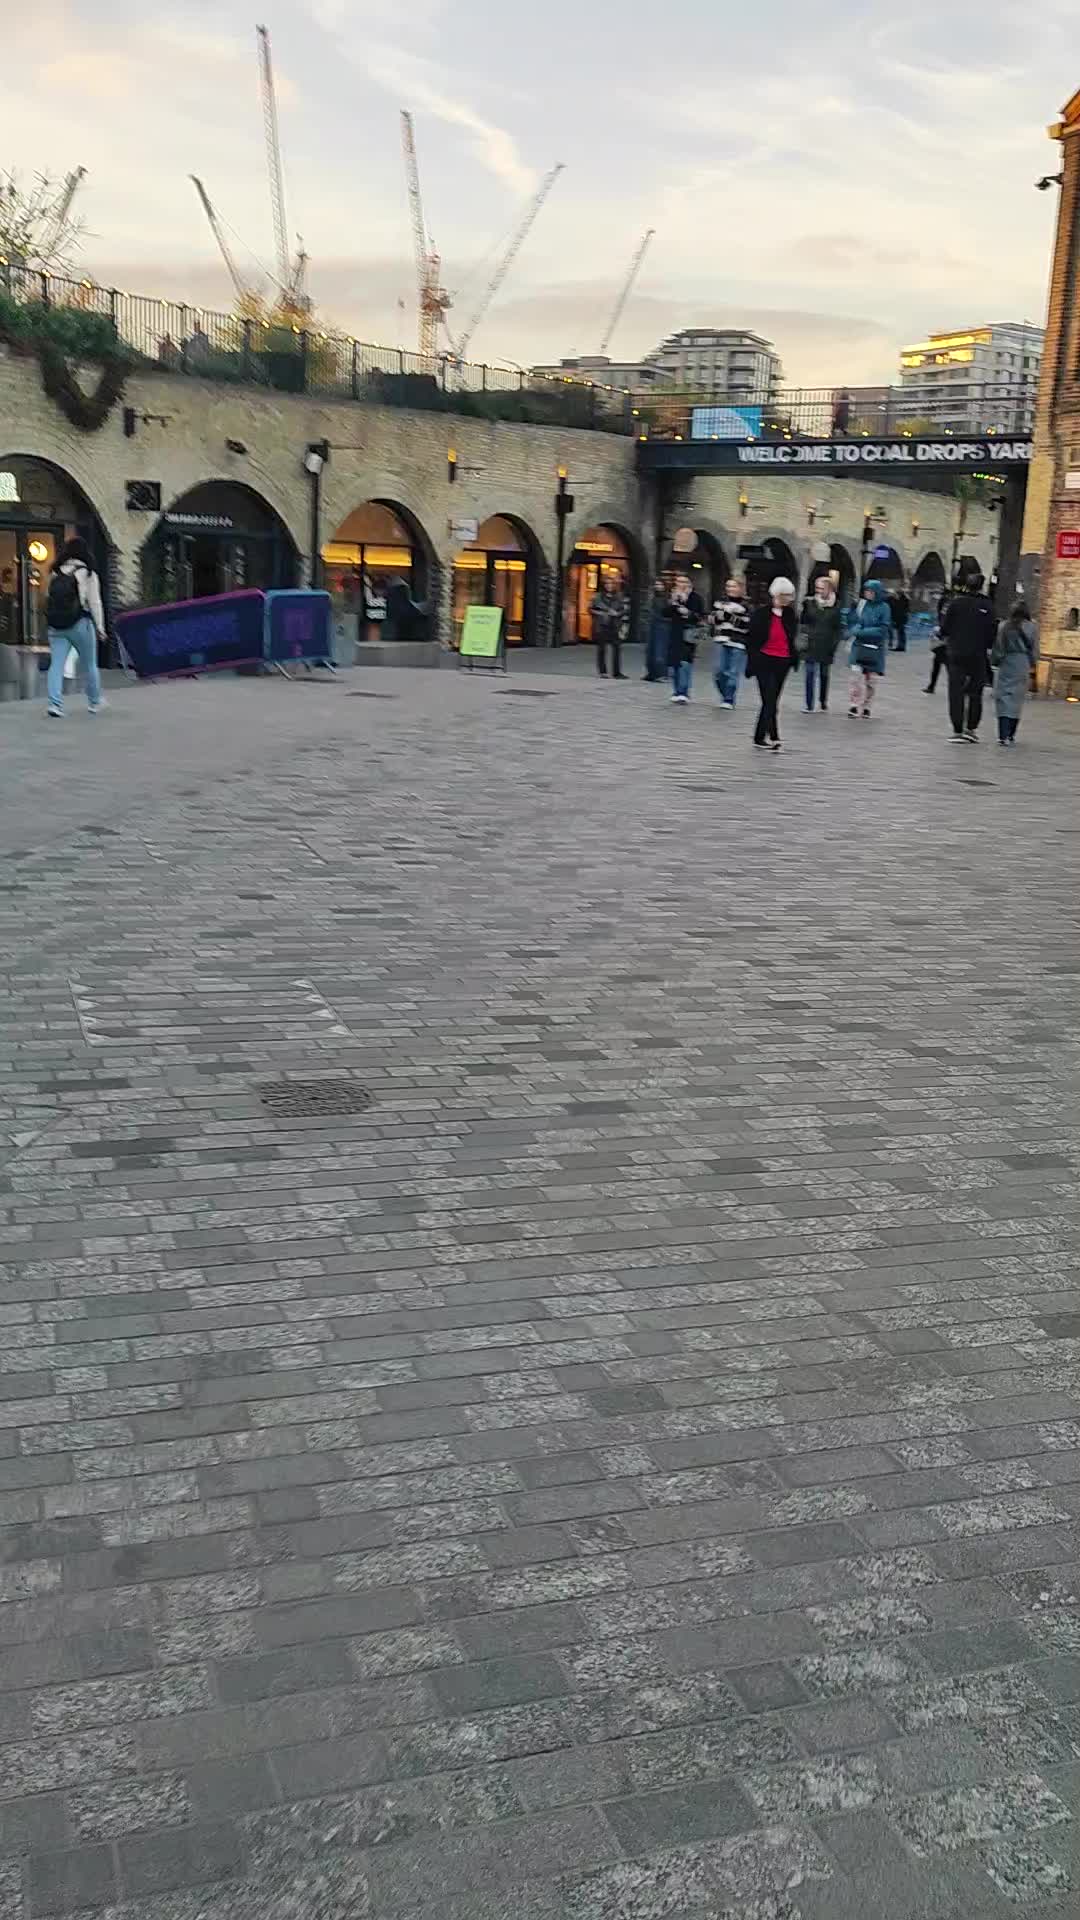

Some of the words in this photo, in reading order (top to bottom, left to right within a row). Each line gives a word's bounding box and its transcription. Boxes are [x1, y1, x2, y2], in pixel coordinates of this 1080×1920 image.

[737, 445, 832, 463] WELCOME
[833, 444, 860, 462] TO
[861, 444, 914, 461] COAL
[916, 443, 985, 461] DROPS
